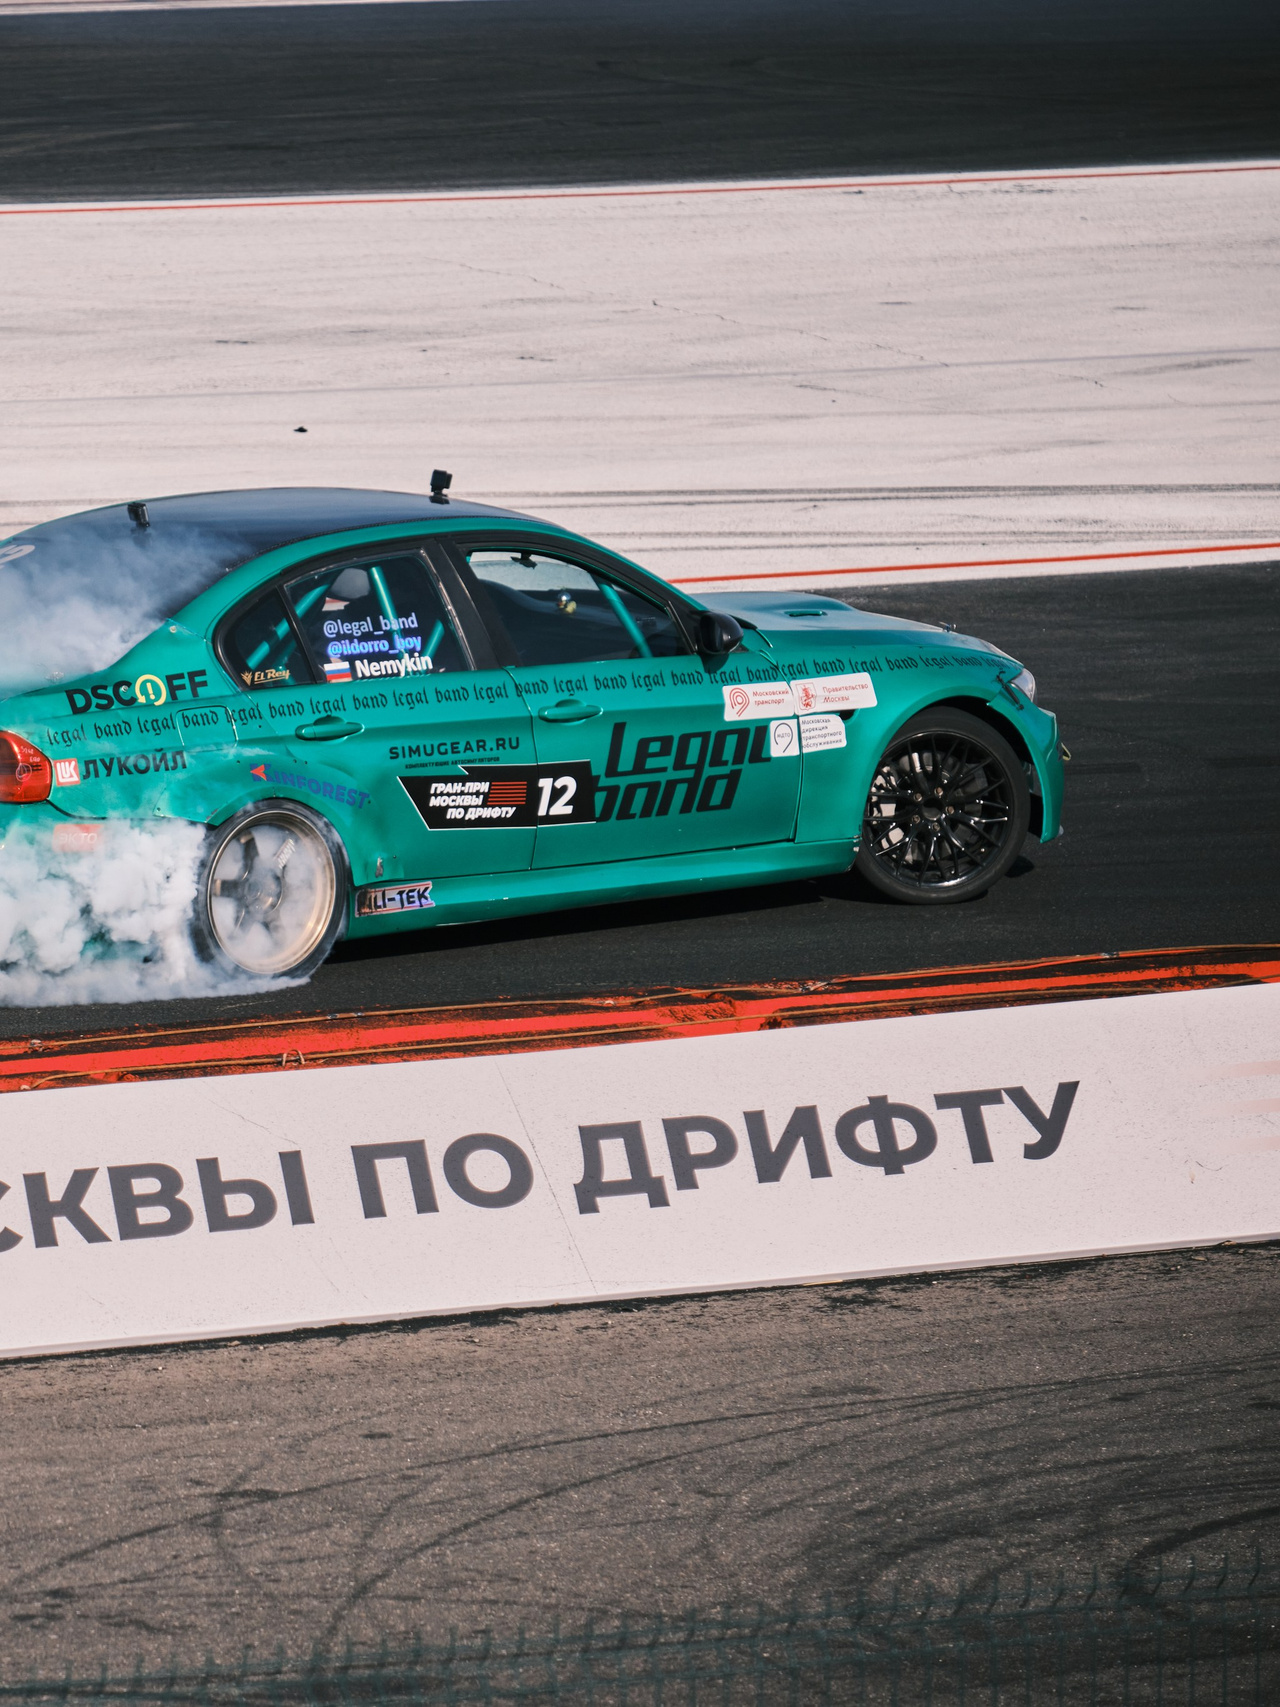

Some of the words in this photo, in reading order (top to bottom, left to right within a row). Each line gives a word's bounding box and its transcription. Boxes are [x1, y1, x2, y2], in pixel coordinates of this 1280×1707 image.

[323, 612, 418, 638] @legal_band
[327, 634, 422, 658] @ildorro_boy
[355, 653, 434, 678] Nemykin
[752, 688, 789, 697] Московский
[823, 682, 869, 694] Правительство
[823, 694, 850, 703] Москвы
[47, 723, 87, 748] legal
[94, 721, 132, 740] band
[137, 714, 176, 736] legal
[182, 709, 219, 729] band
[269, 702, 305, 719] band
[310, 697, 347, 715] legal
[353, 691, 387, 710] band
[392, 686, 429, 710] legal
[435, 686, 470, 703] band
[473, 681, 509, 703] legal
[514, 680, 549, 697] band
[553, 675, 588, 697] legal
[594, 674, 627, 691] band
[631, 669, 666, 691] legal
[671, 669, 704, 686] band
[746, 664, 778, 682] band
[813, 658, 846, 674] band
[885, 656, 919, 671] band
[754, 697, 785, 706] транспорт
[389, 736, 520, 760] SIMUGEAR.RU
[82, 748, 187, 780] ЛУКОЙЛ
[250, 763, 371, 809] KINFOREST
[430, 781, 490, 795] ГРАН-ПРИ
[537, 775, 578, 817] 12
[429, 794, 483, 807] МОСКВЫ
[446, 807, 465, 820] ПО
[465, 806, 517, 821] ДРИФТУ
[350, 1131, 535, 1220] ПО
[572, 1080, 1081, 1215] ДРИФТУ
